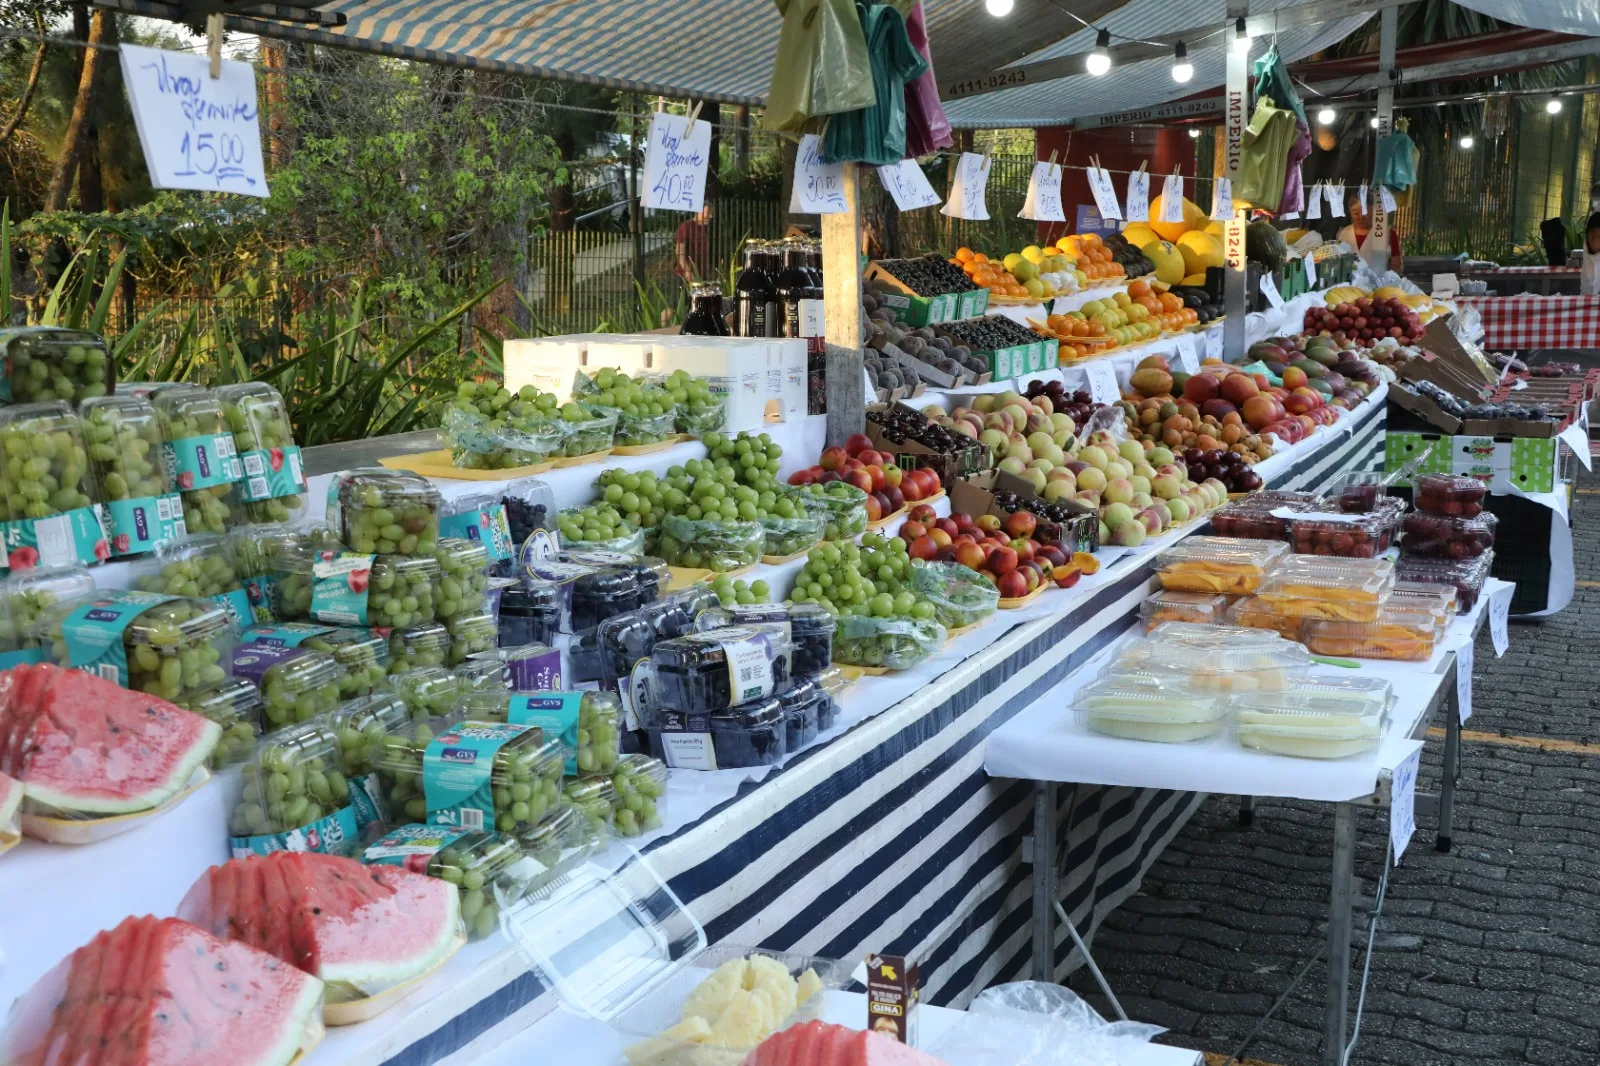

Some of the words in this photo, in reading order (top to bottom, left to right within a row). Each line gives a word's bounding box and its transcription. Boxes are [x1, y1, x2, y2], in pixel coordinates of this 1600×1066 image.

[948, 70, 1026, 95] 4111-8243
[1100, 110, 1151, 125] IMPERIO
[1157, 100, 1217, 116] 4111-8243
[1228, 91, 1242, 171] IMPERIO
[456, 750, 476, 760] GVS
[872, 1004, 899, 1015] GINA
